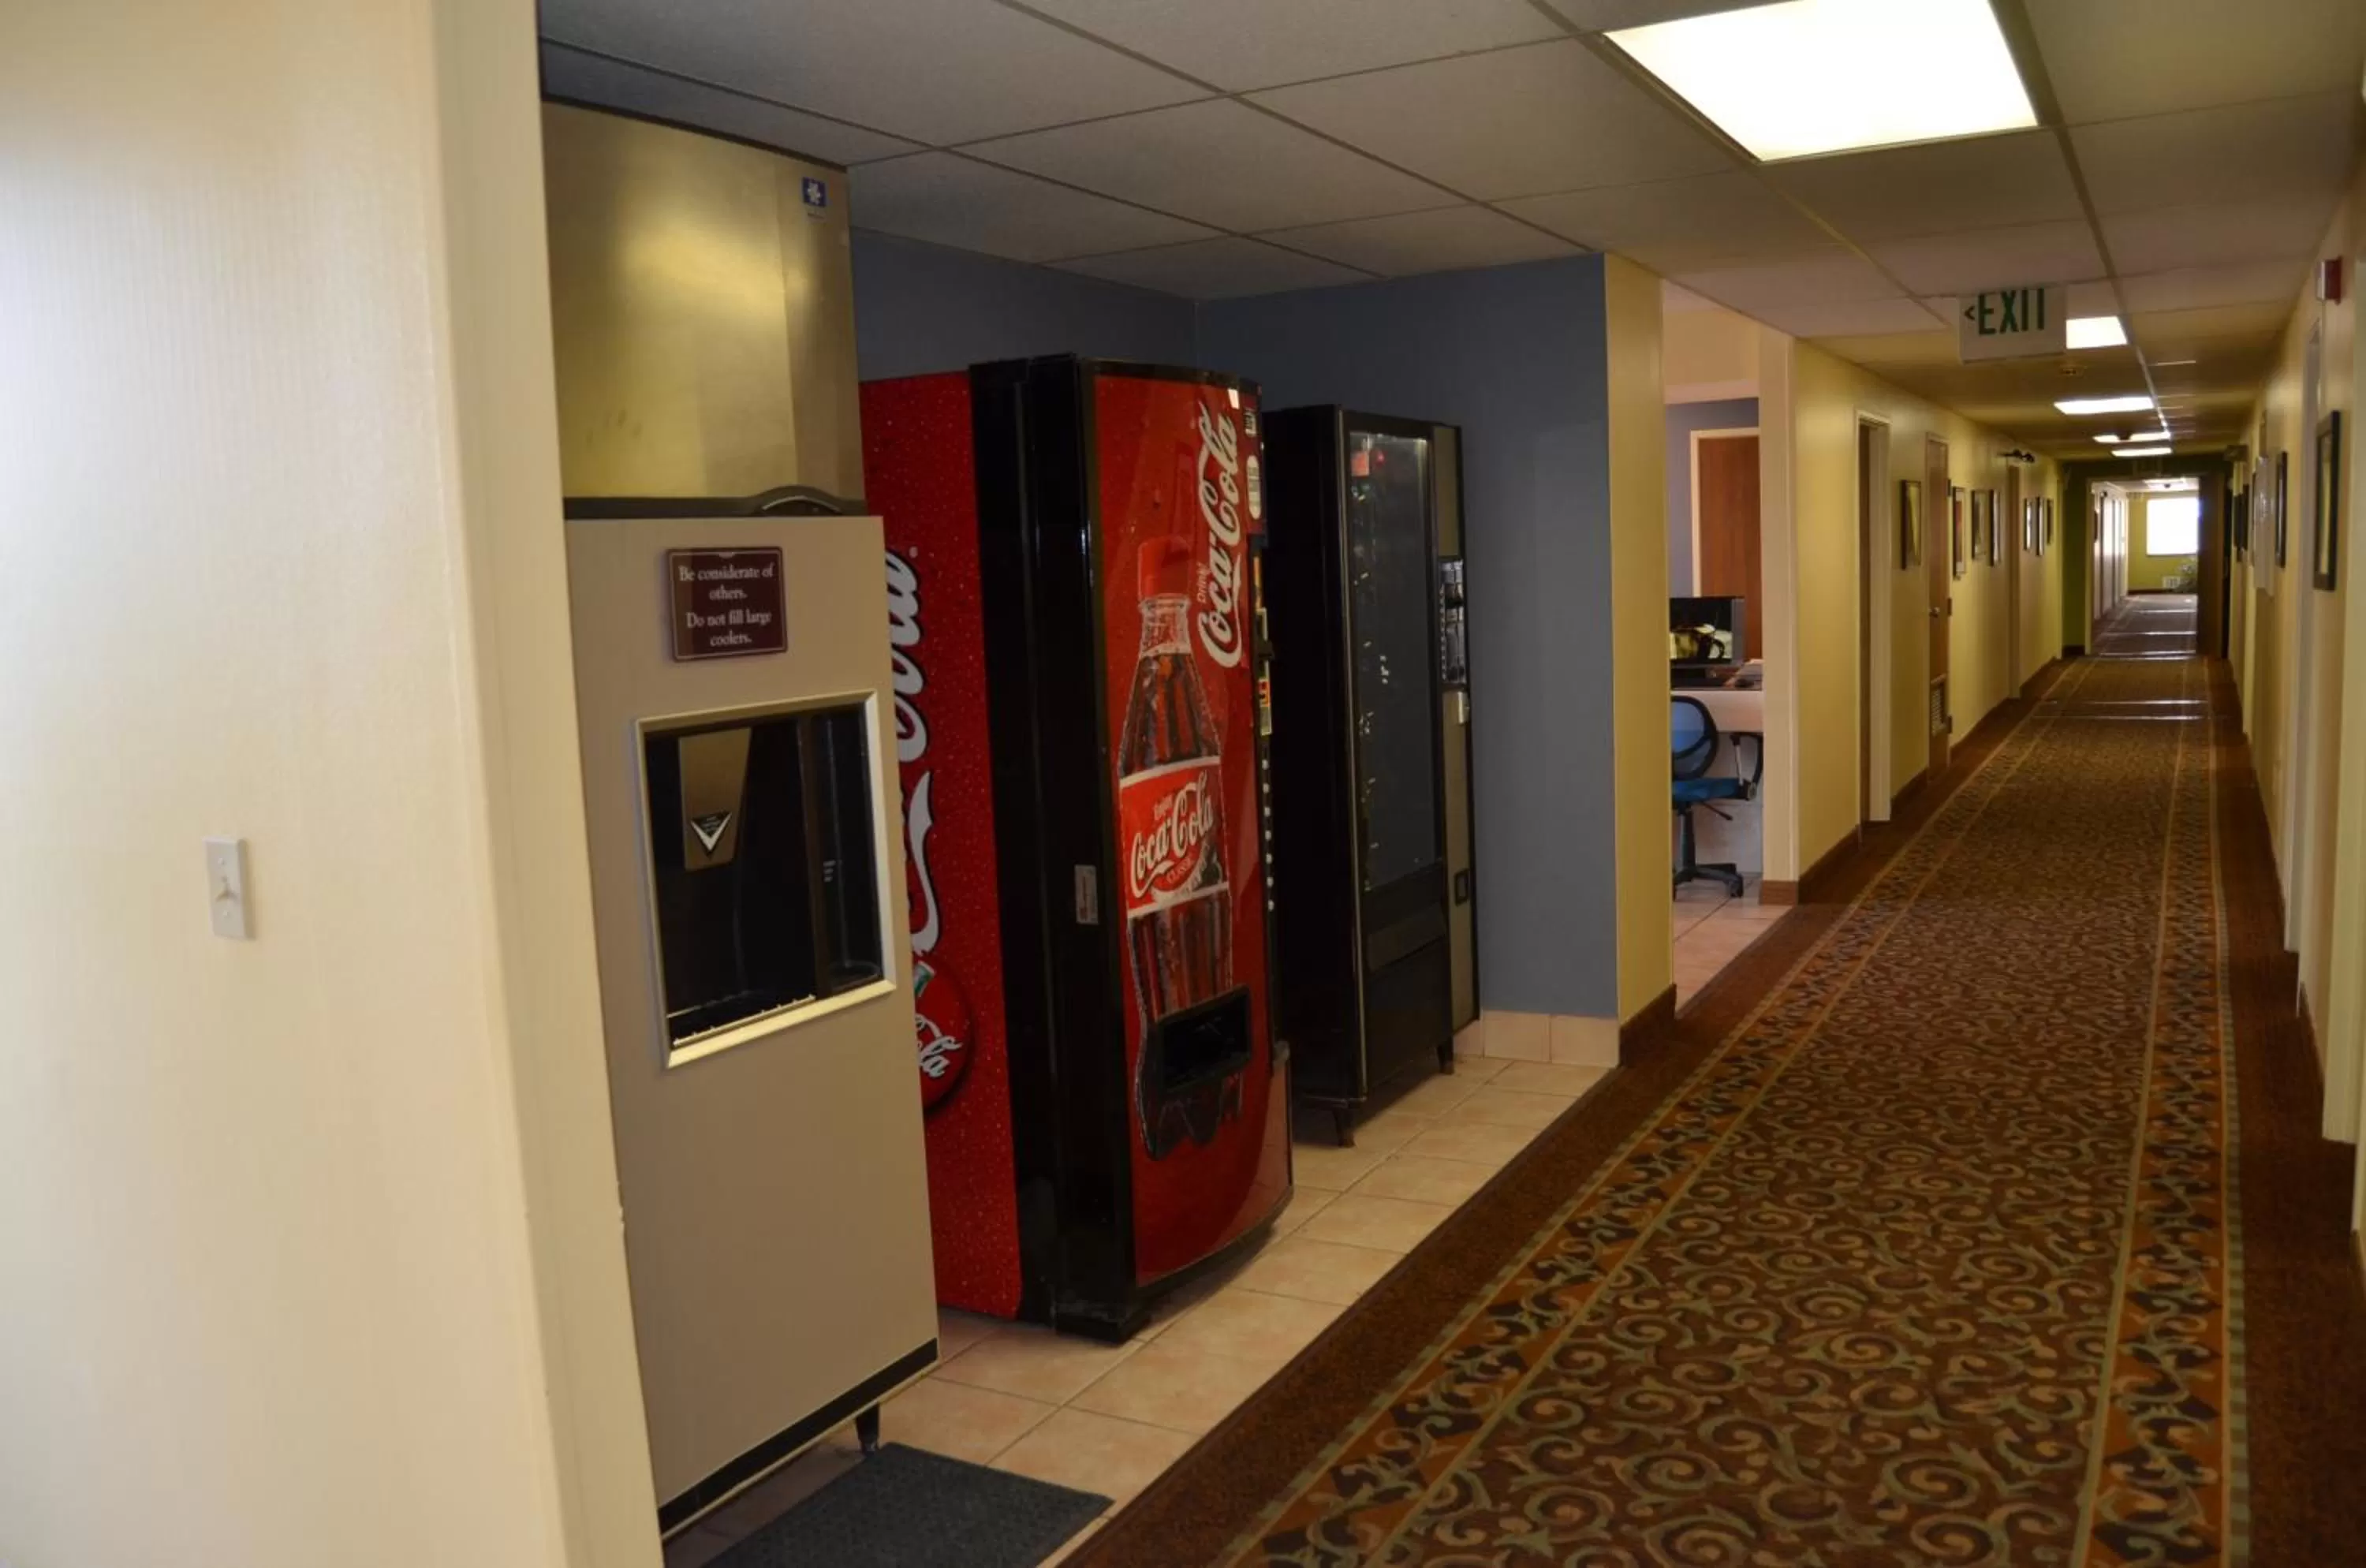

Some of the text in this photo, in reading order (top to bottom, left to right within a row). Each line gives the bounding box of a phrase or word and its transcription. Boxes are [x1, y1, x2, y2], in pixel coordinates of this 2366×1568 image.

[1198, 401, 1243, 669] Coca-Cola
[679, 562, 774, 581] Be considerate of
[709, 584, 748, 600] others.
[686, 609, 771, 628] Do not fill large
[710, 630, 752, 646] coolers.
[1131, 770, 1213, 898] Coca-Cola
